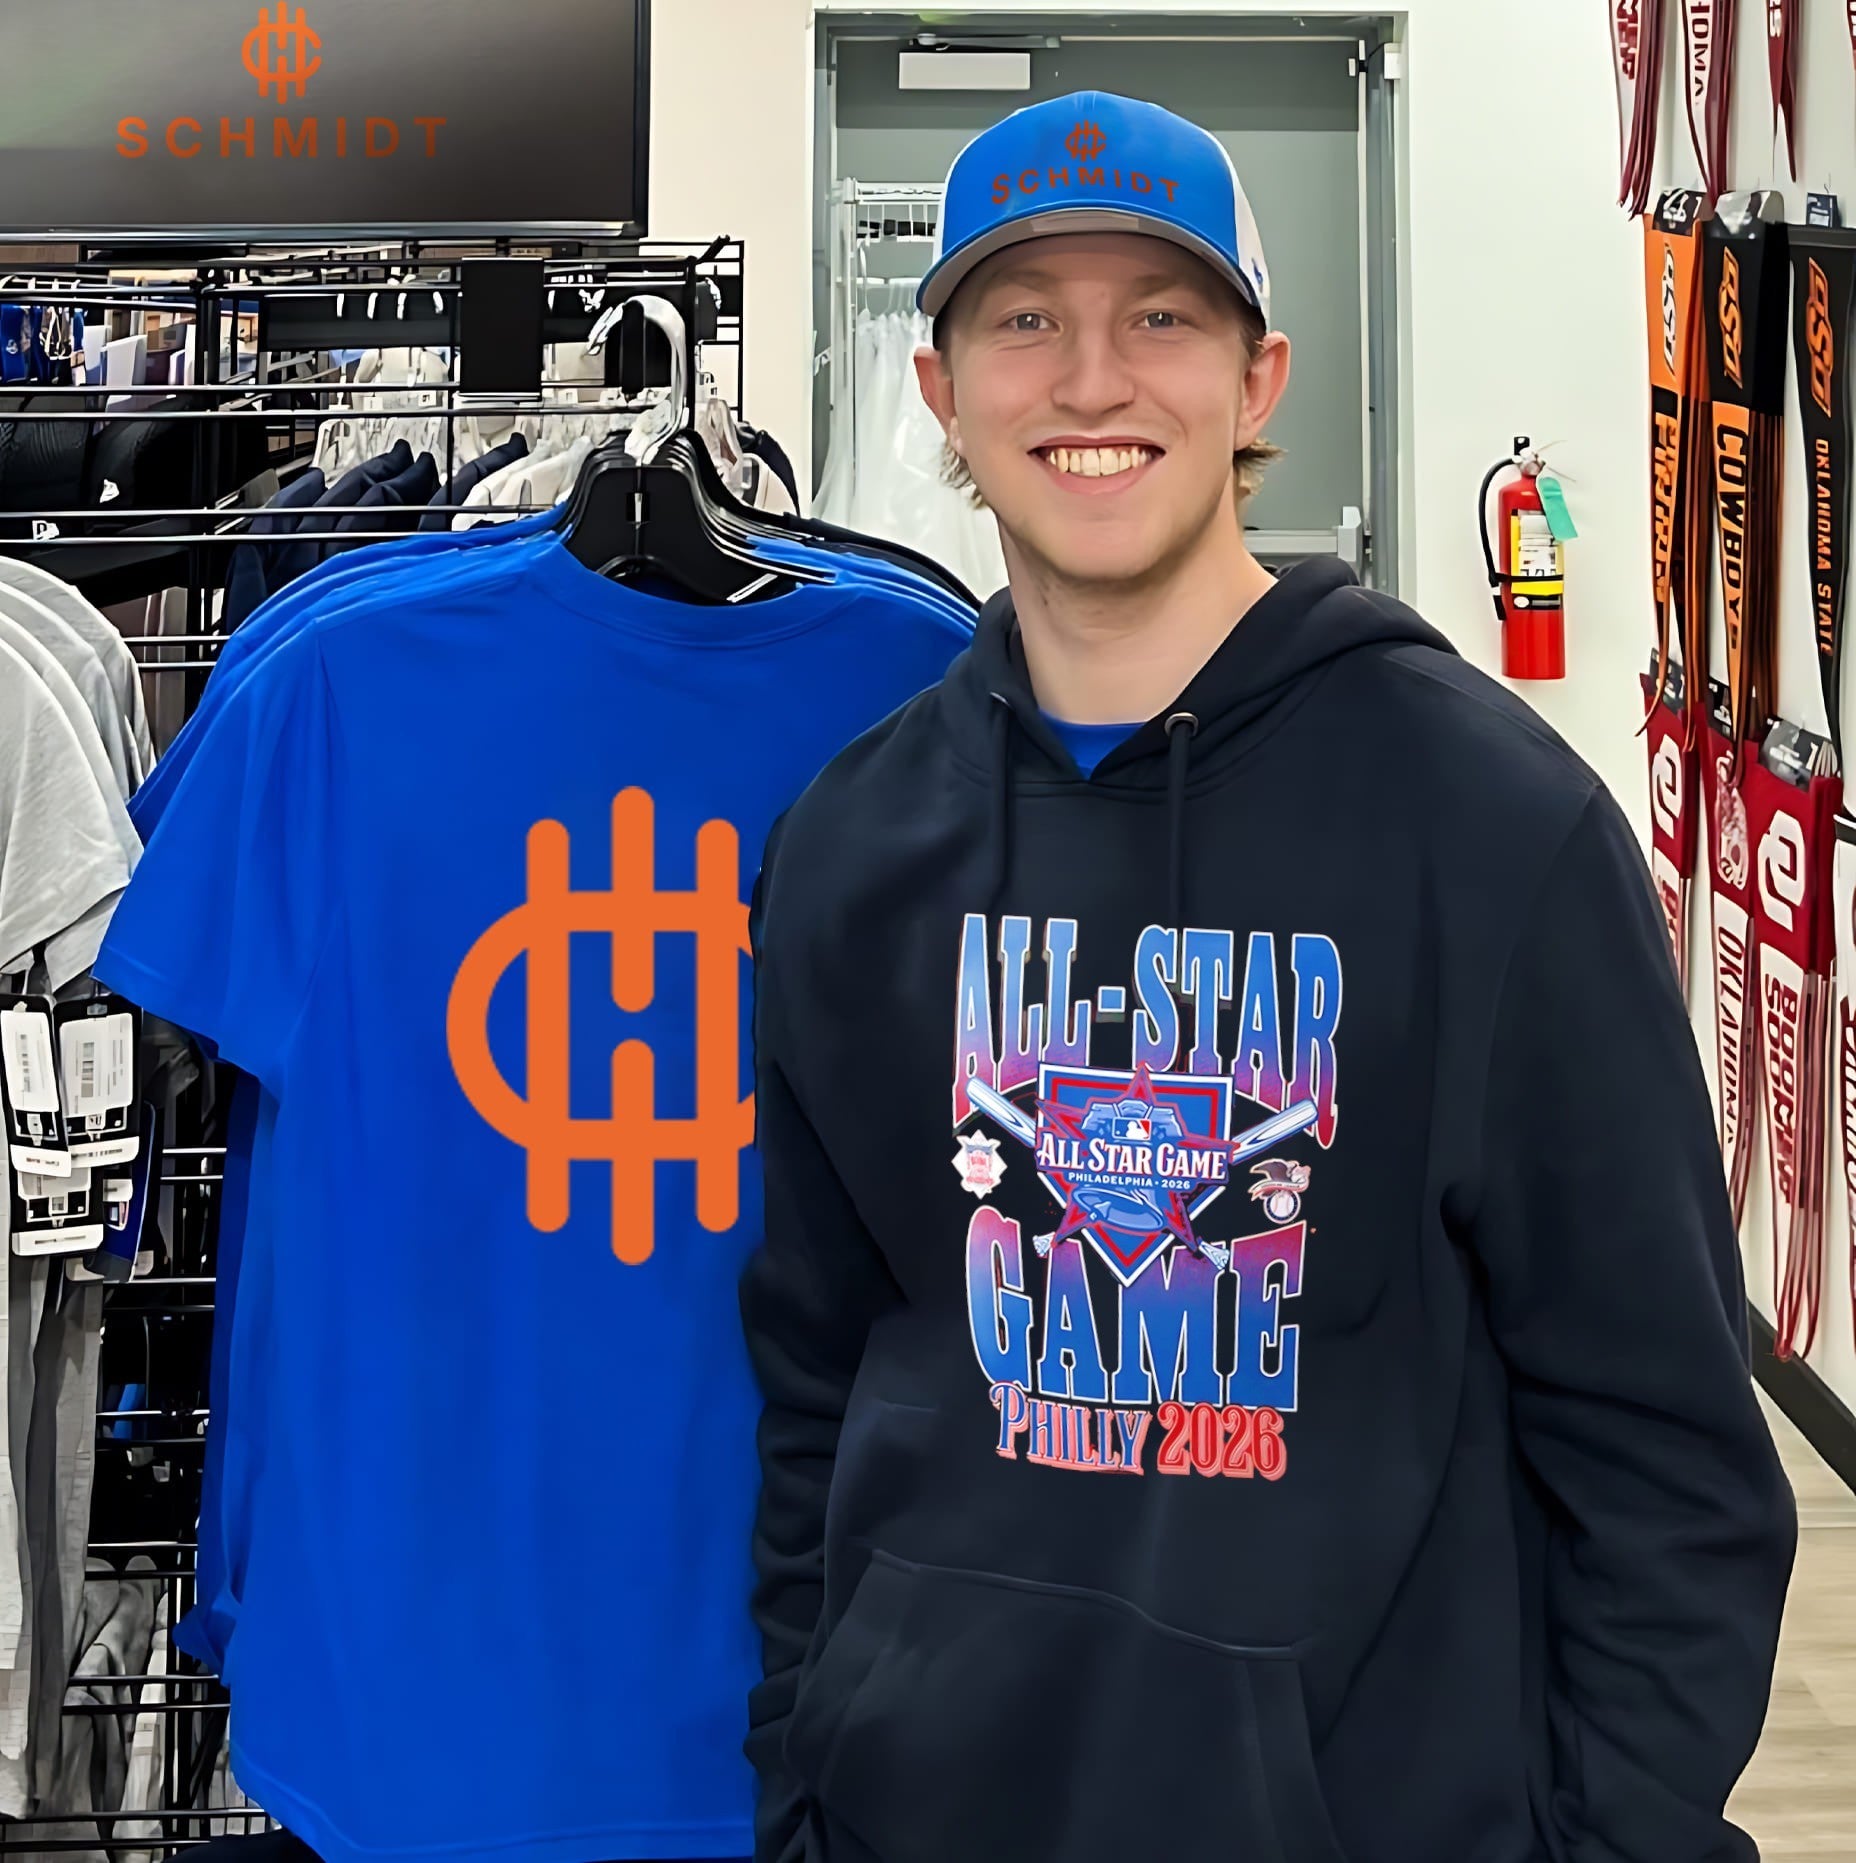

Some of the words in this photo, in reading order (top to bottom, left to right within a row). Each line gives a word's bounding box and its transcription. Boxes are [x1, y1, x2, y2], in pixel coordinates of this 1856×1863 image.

[116, 116, 448, 159] SCHMIDT
[991, 166, 1180, 204] SCHMIDT
[952, 913, 1343, 1150] ALL-STAR
[1718, 925, 1744, 1144] OKLAHOMA
[1036, 1132, 1085, 1170] ALL
[1087, 1137, 1153, 1175] STAR
[1155, 1142, 1228, 1180] GAME
[1068, 1172, 1154, 1188] PHILADELPHIA
[1161, 1178, 1191, 1190] 2026
[966, 1204, 1307, 1412] GAME
[988, 1381, 1153, 1476] PHILLY
[1157, 1402, 1287, 1482] 2026
